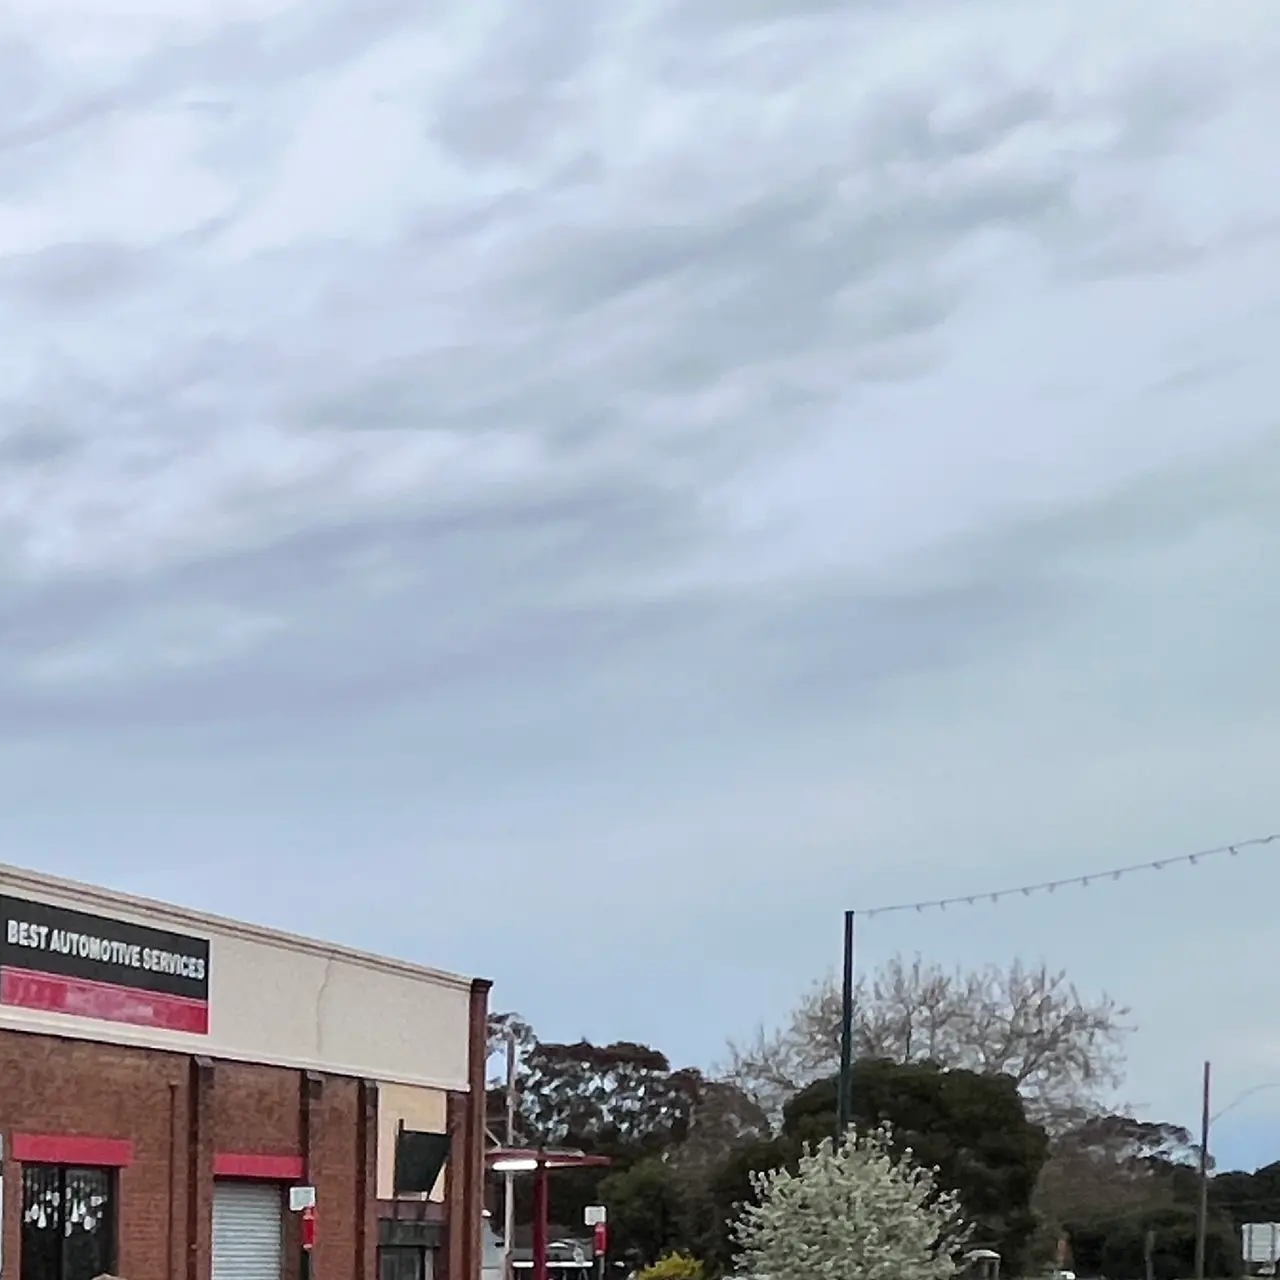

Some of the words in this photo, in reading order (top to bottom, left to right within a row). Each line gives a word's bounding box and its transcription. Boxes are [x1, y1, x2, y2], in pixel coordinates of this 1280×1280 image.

[7, 919, 49, 948] BEST
[50, 929, 140, 967] AUTOMOTIVE
[143, 947, 205, 980] SERVICES
